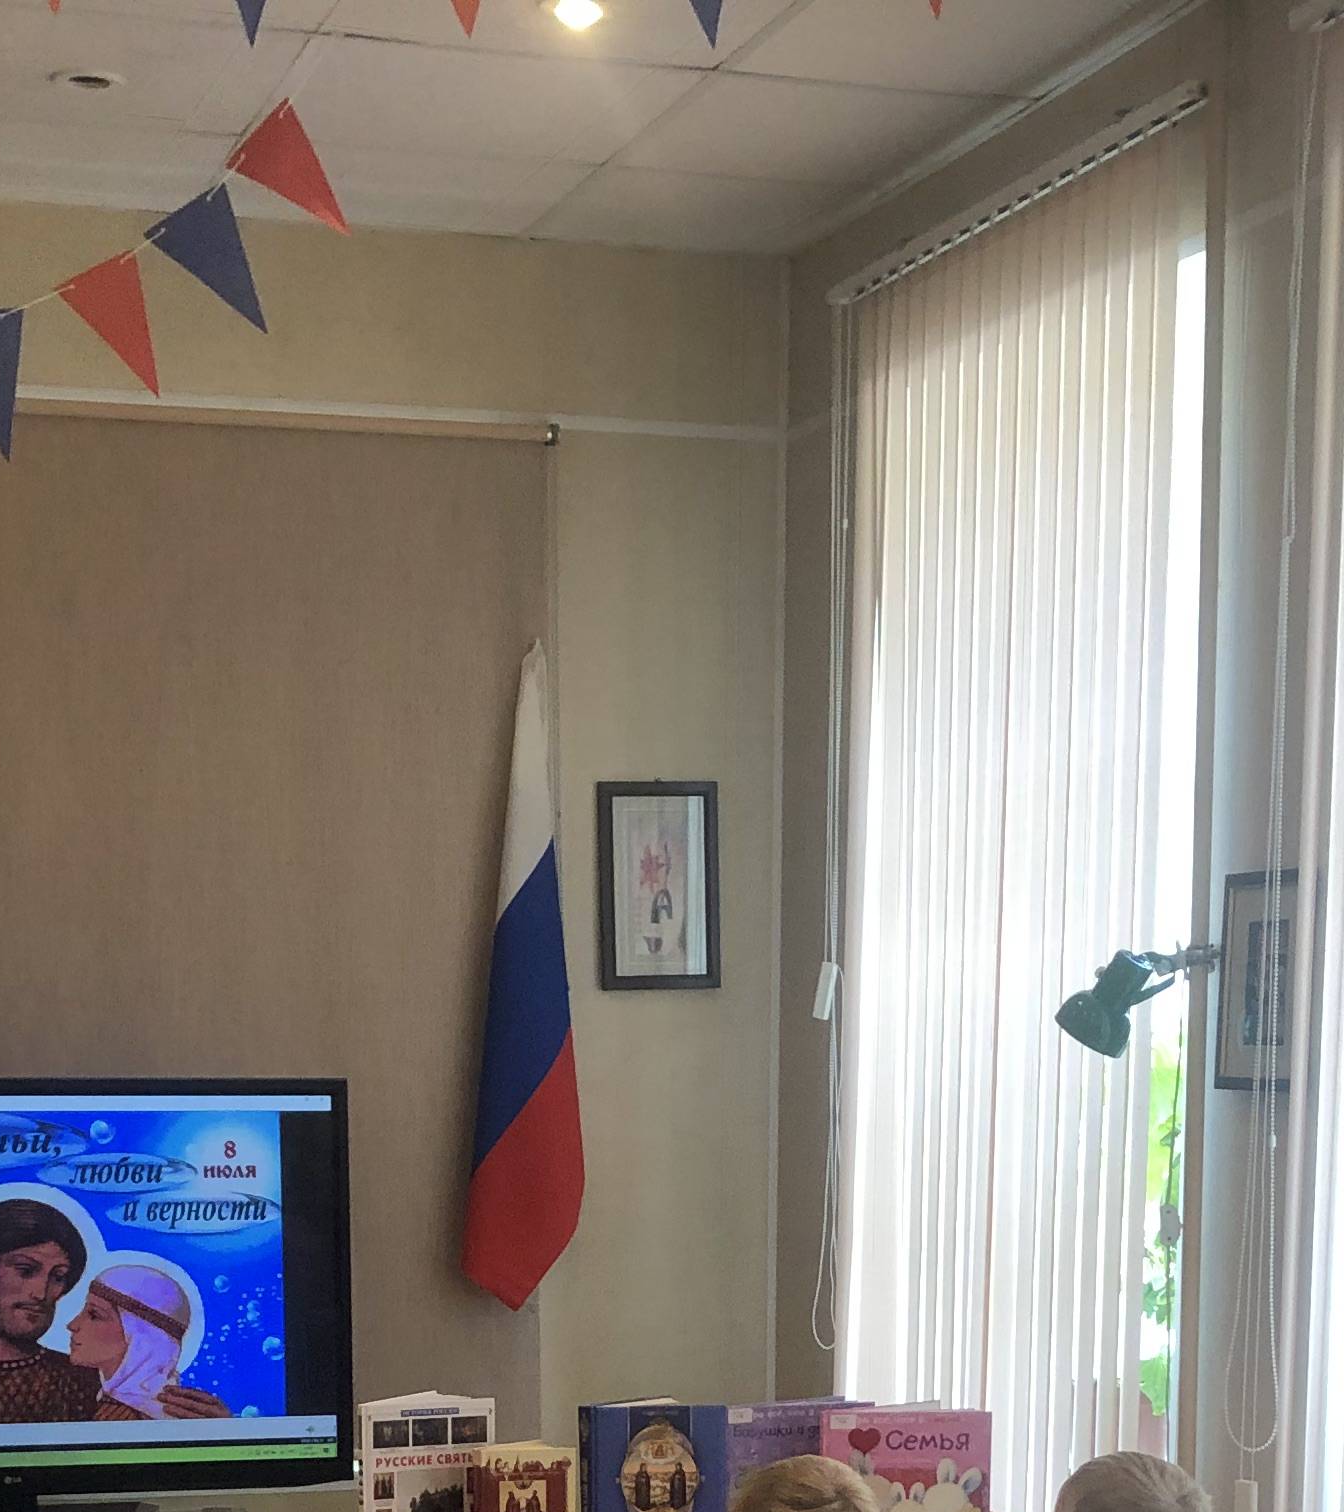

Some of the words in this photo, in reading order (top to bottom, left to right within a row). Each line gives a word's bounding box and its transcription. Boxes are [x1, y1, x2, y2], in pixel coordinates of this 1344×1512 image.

[223, 1140, 237, 1159] 8
[68, 1155, 163, 1185] любви
[203, 1164, 258, 1179] июля
[122, 1199, 140, 1223] и
[146, 1198, 268, 1230] верности
[885, 1429, 971, 1451] Семья
[375, 1454, 433, 1468] РУССКИЕ
